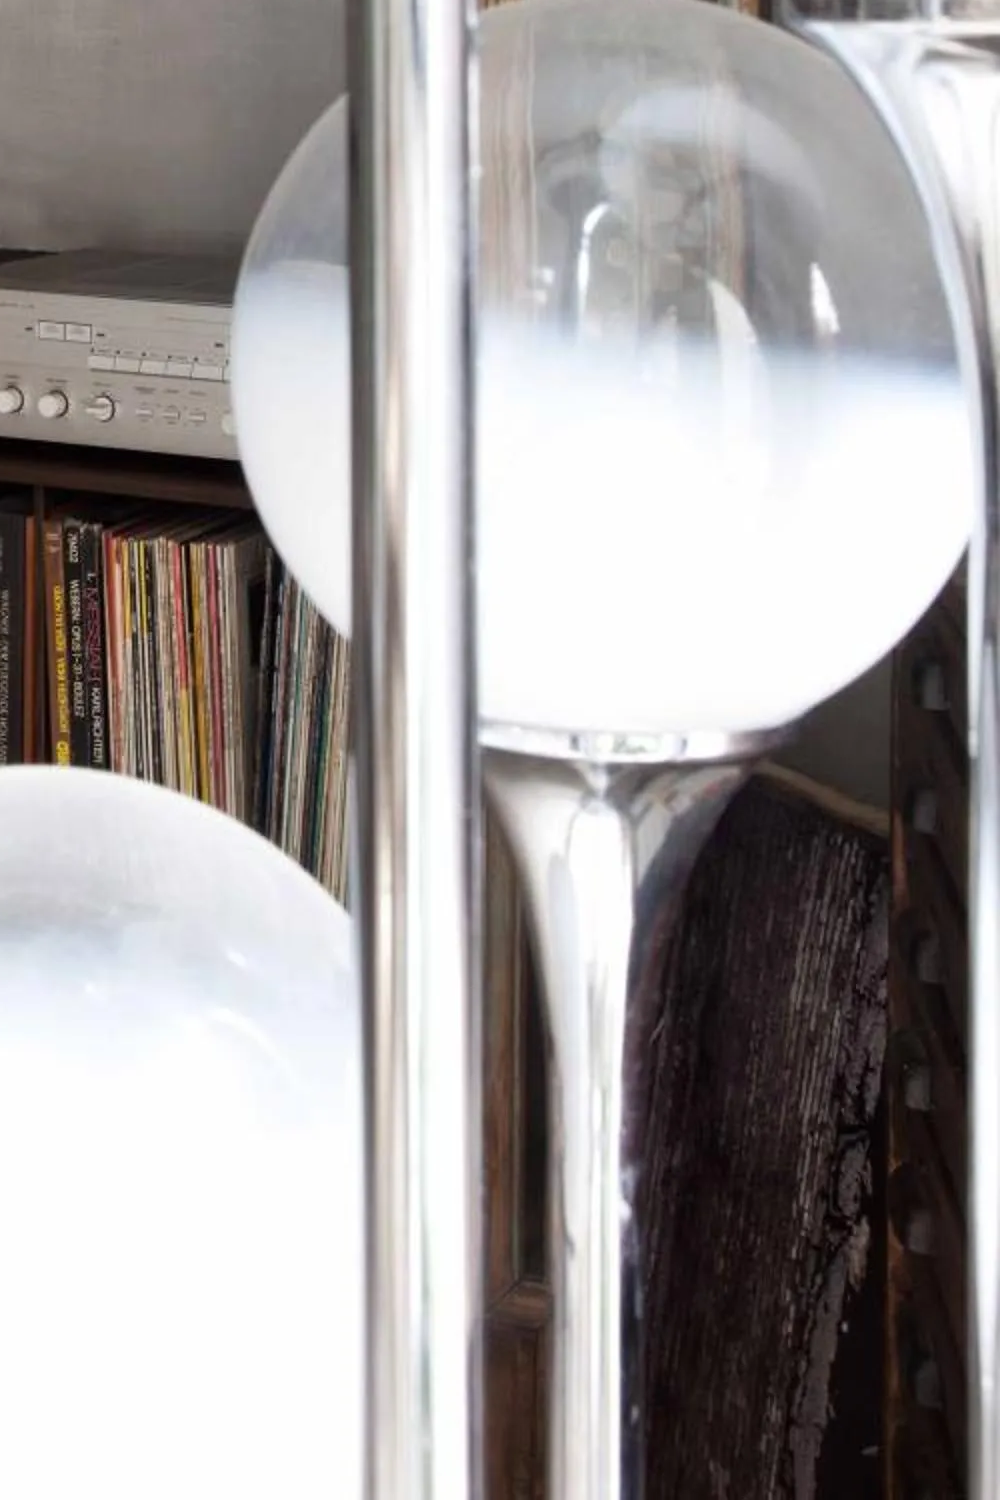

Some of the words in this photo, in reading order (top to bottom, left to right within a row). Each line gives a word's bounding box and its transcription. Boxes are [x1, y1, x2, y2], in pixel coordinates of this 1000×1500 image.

[71, 625, 81, 652] OPUS
[74, 681, 84, 718] BOULEZ
[91, 687, 101, 714] KARL
[92, 716, 102, 763] RICHTER
